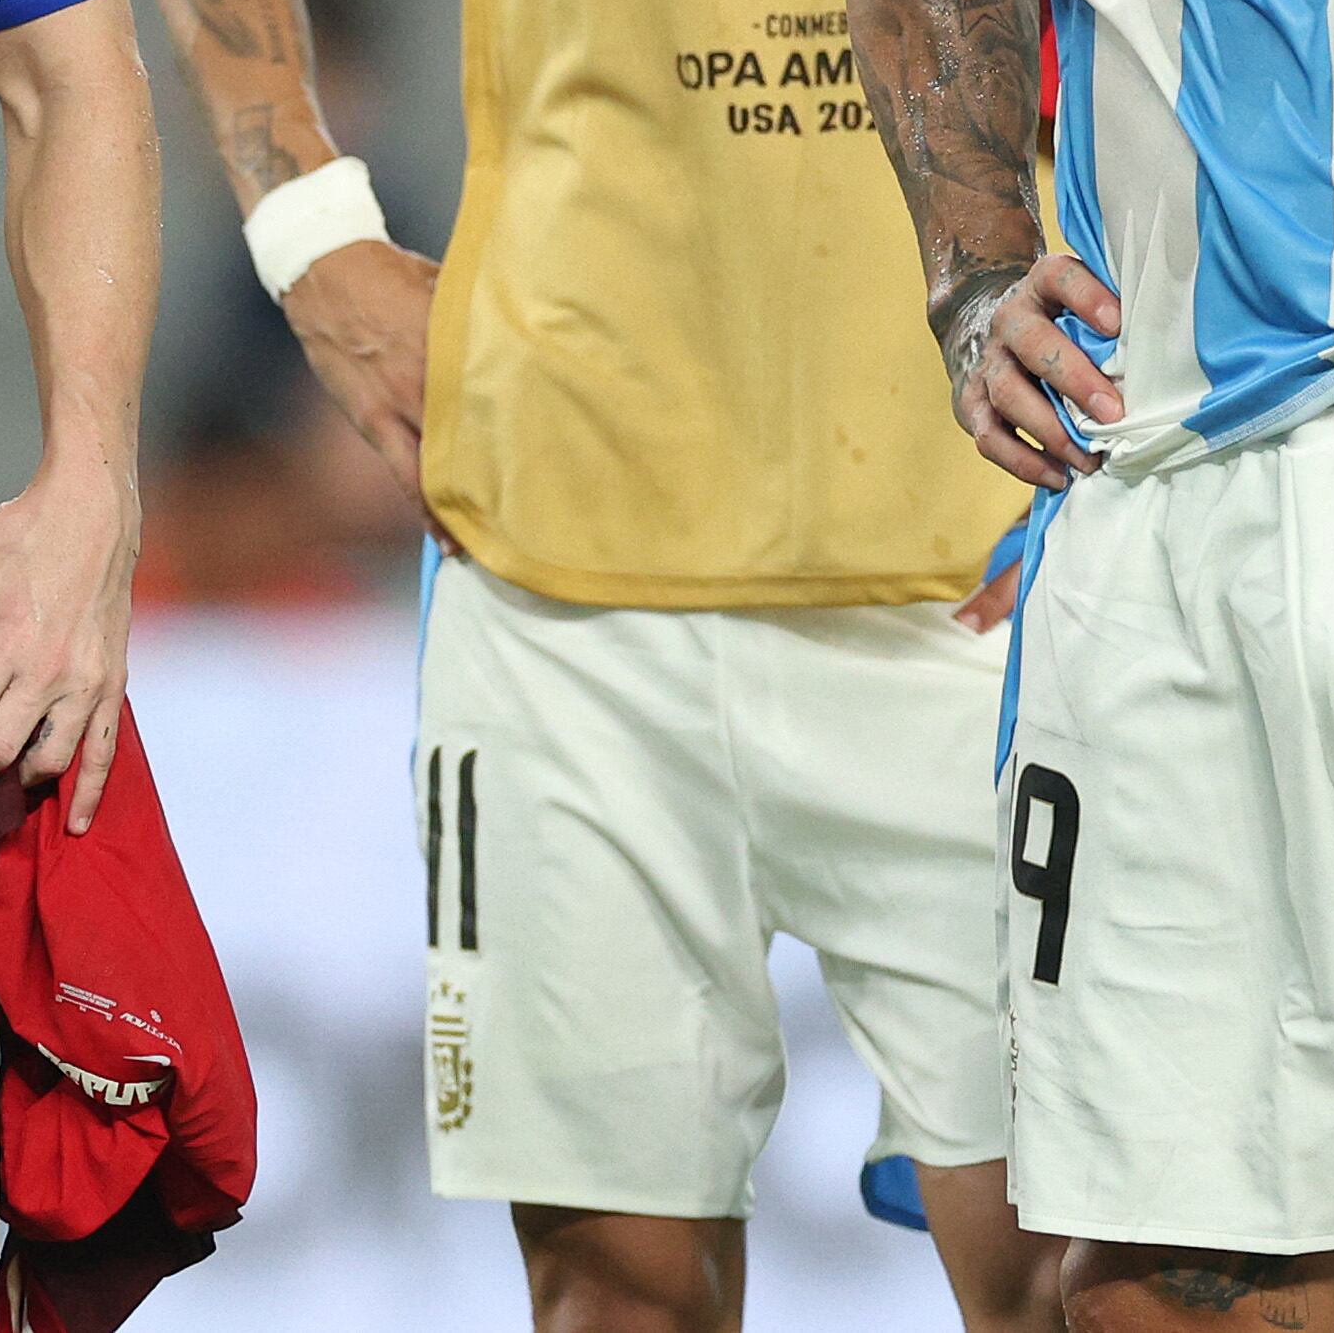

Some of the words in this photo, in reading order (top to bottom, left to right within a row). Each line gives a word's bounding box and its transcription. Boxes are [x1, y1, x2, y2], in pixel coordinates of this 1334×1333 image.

[727, 102, 802, 136] USA
[427, 745, 479, 951] 11
[1011, 752, 1081, 987] 9
